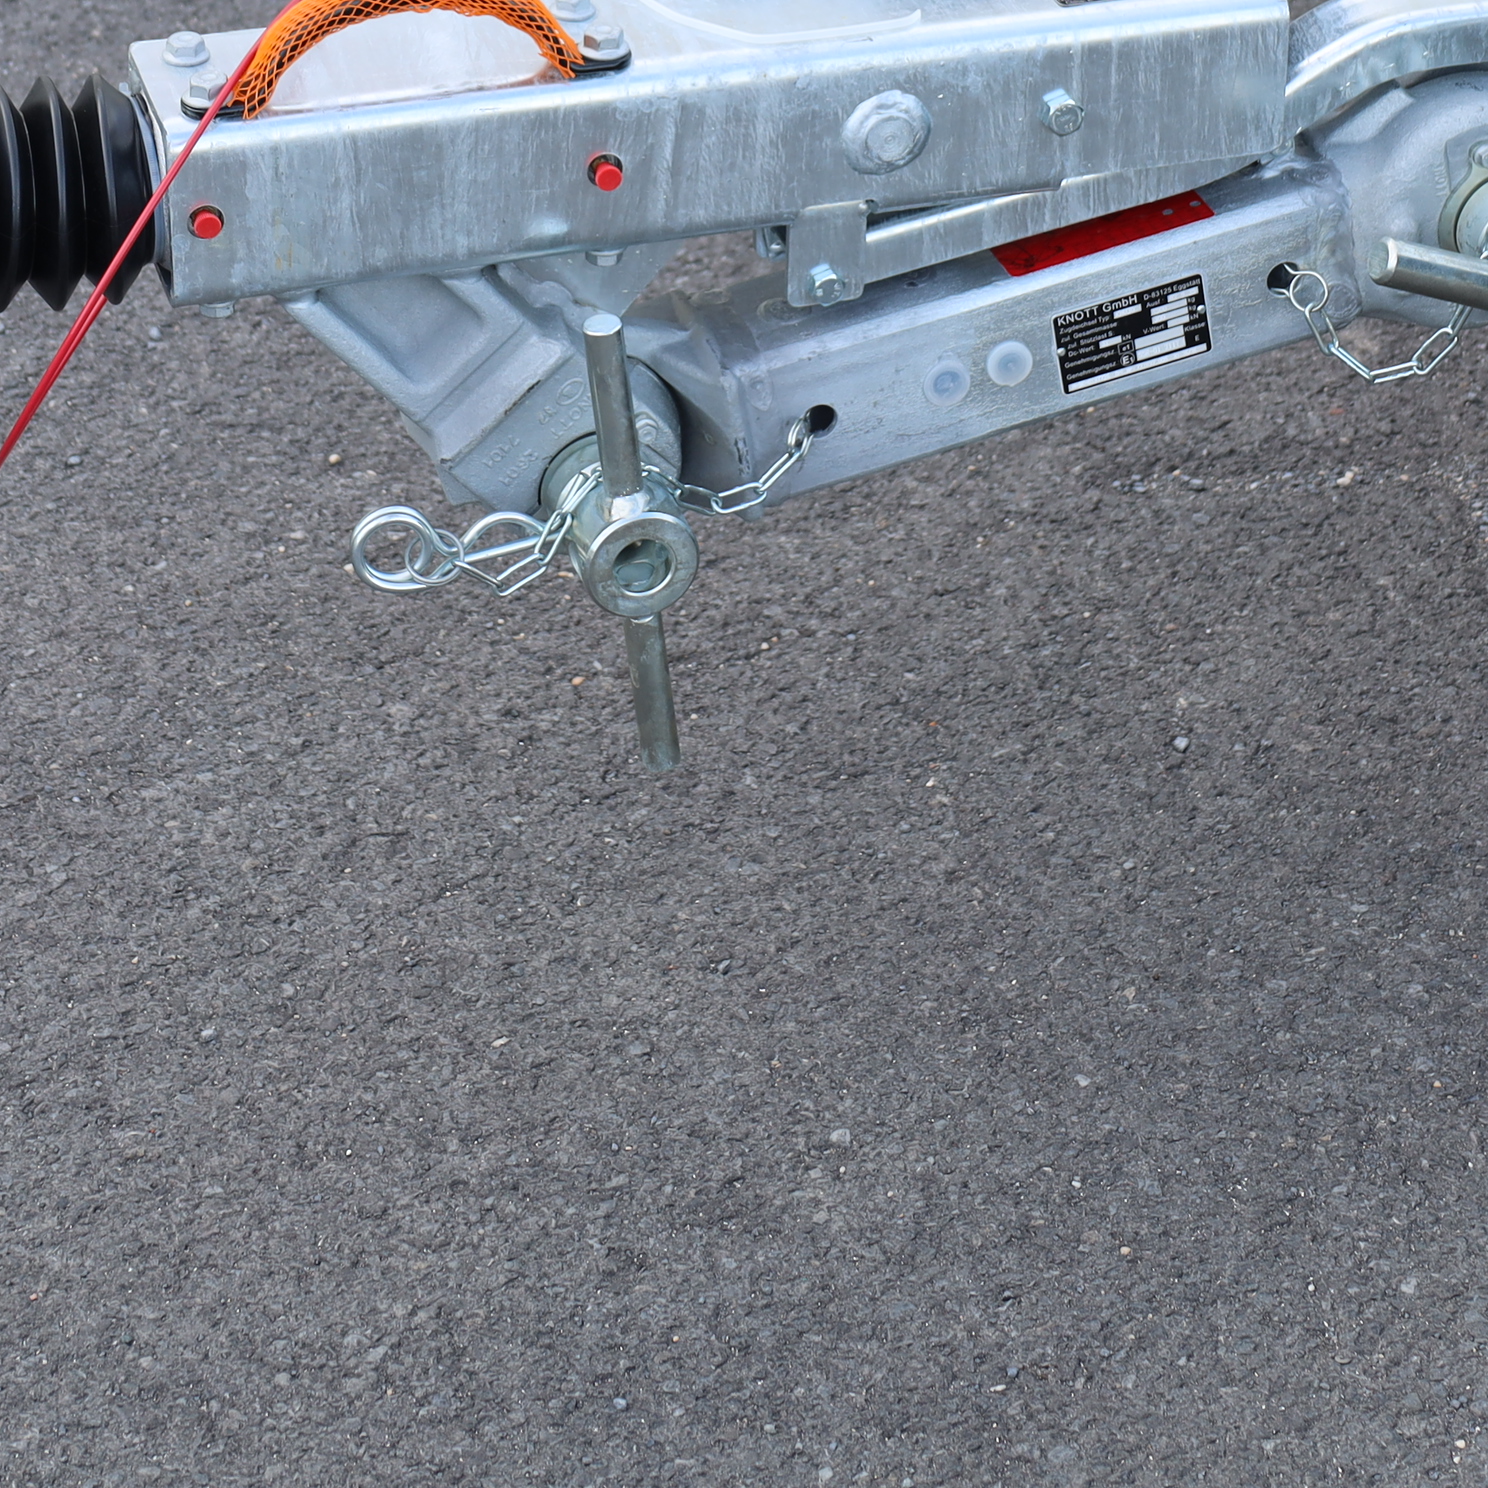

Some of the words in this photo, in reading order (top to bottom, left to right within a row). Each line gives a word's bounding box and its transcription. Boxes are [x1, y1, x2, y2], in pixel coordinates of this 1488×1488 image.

[1057, 305, 1099, 327] KNOTT
[1102, 294, 1138, 313] GmbH
[1143, 286, 1172, 301] D-83125
[1184, 321, 1206, 333] Klasse
